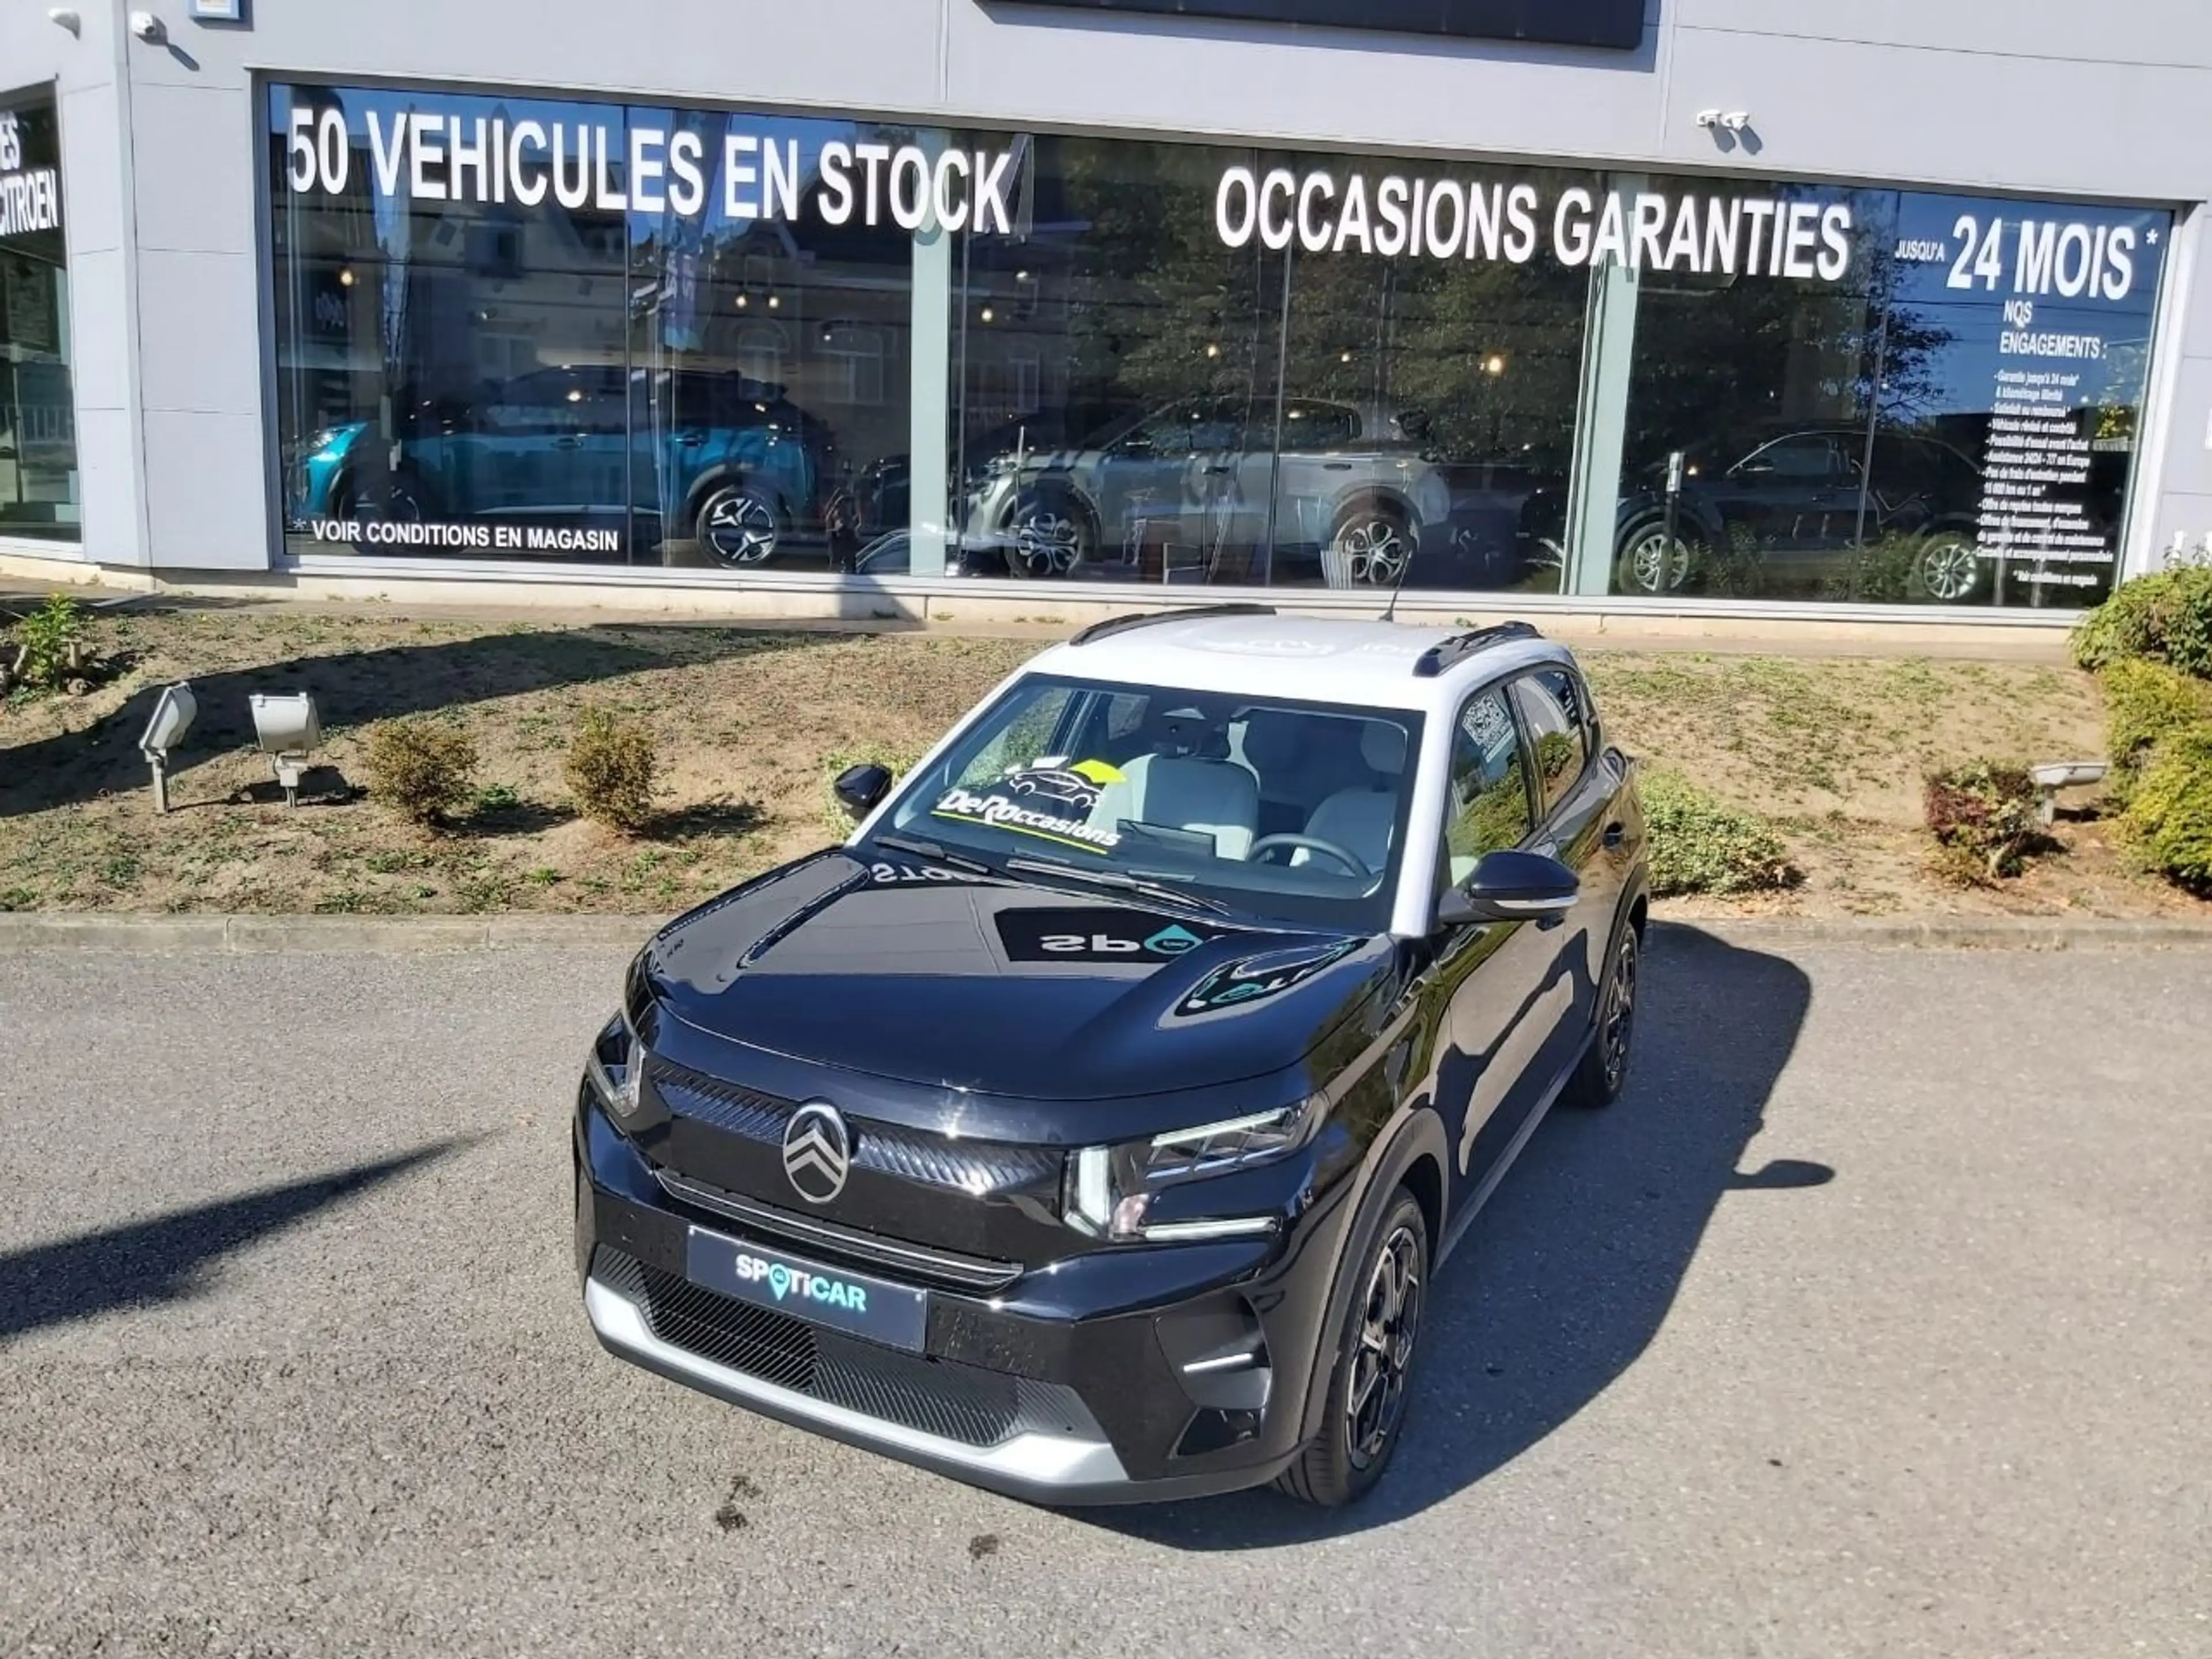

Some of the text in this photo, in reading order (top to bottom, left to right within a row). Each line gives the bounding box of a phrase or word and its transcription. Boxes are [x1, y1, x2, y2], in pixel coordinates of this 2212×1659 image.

[290, 108, 1011, 234] 50 VEHICULES EN STOCK
[1216, 166, 1945, 282] OCCASIONS GARANTIES JUSQU'A
[1946, 214, 2003, 290] 24
[2014, 221, 2135, 300] MOIS
[1999, 331, 2101, 359] ENGAGEMENTS
[312, 520, 361, 542] VOIR
[367, 522, 490, 547] CONDITIONS
[495, 527, 522, 548] EN
[527, 529, 618, 551] MAGASIN
